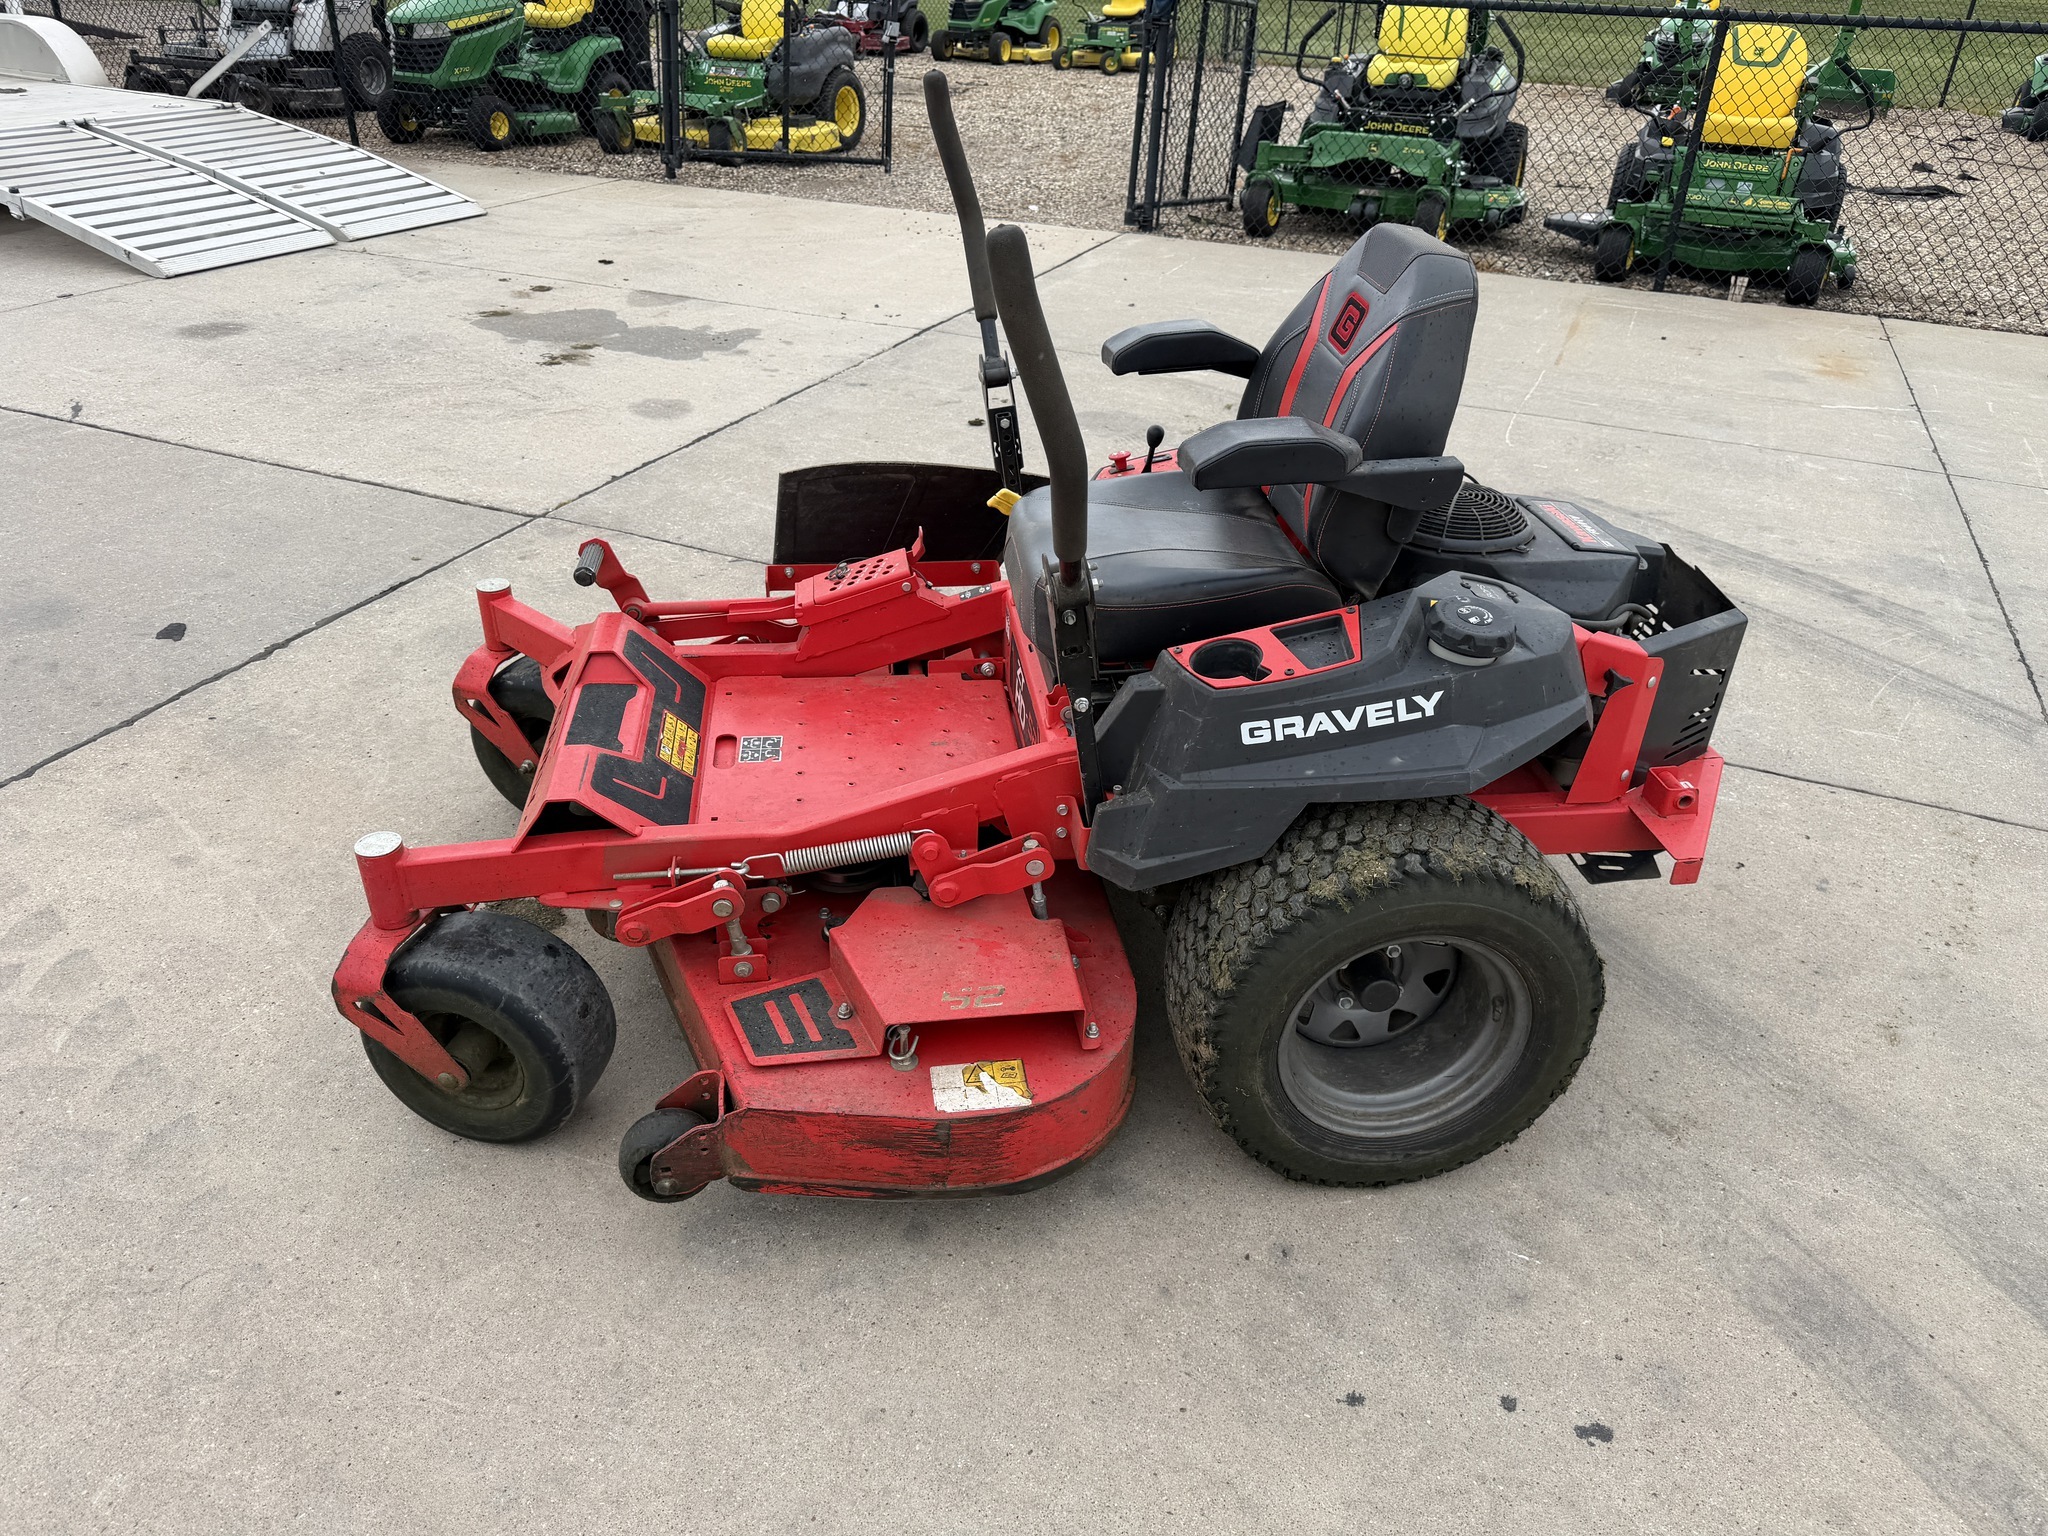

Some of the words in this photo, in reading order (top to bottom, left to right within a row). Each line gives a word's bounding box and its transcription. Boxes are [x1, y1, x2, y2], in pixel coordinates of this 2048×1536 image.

[704, 77, 725, 86] JOHN
[725, 78, 752, 88] DEERE
[1364, 120, 1393, 132] JOHN
[1394, 122, 1430, 135] DEERE
[1703, 158, 1732, 170] JOHN
[1733, 160, 1769, 173] DEERE
[1240, 690, 1445, 746] GRAVELY
[941, 984, 1006, 1011] 52
